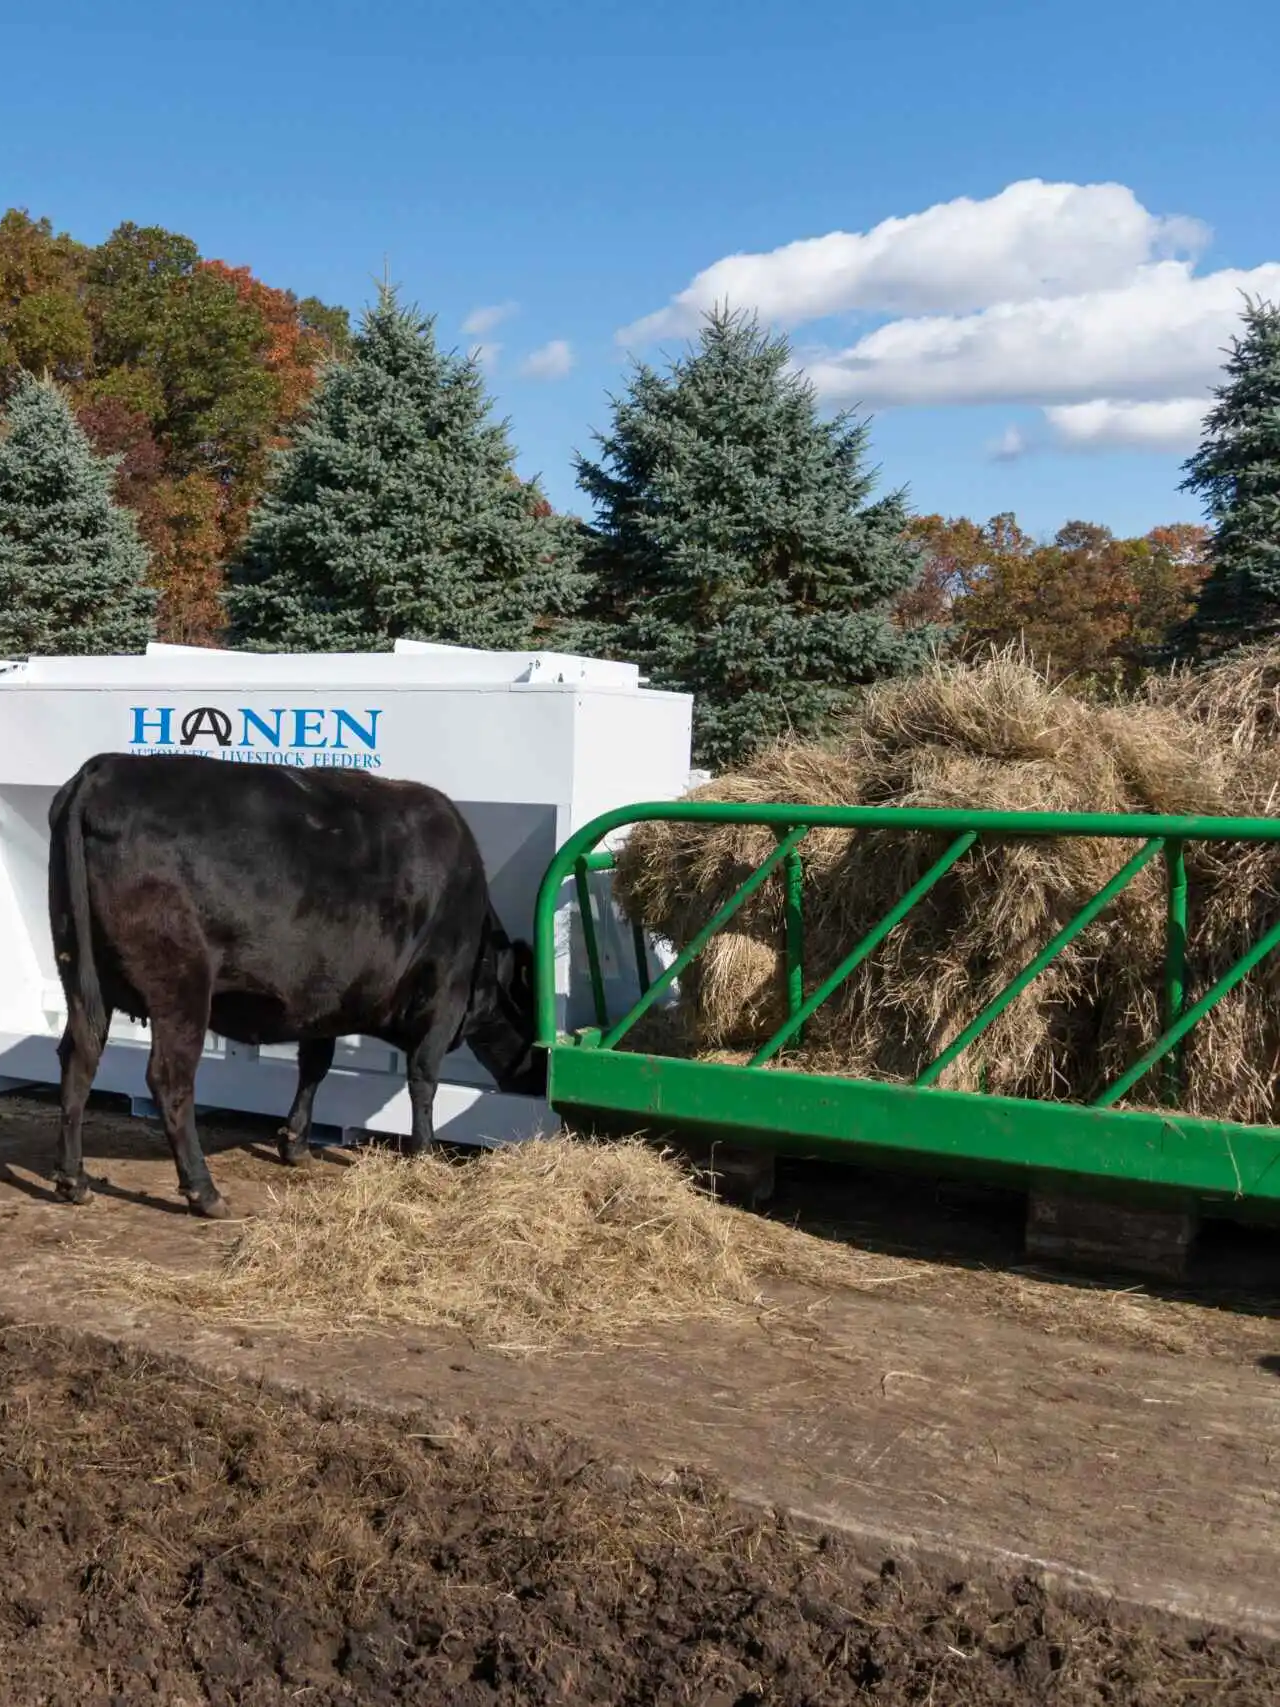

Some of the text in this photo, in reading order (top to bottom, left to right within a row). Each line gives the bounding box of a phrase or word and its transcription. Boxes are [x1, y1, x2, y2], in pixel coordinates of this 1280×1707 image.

[129, 707, 383, 750] HANEN
[221, 750, 306, 766] LIVESTOCK
[312, 752, 382, 769] FEEDERS
